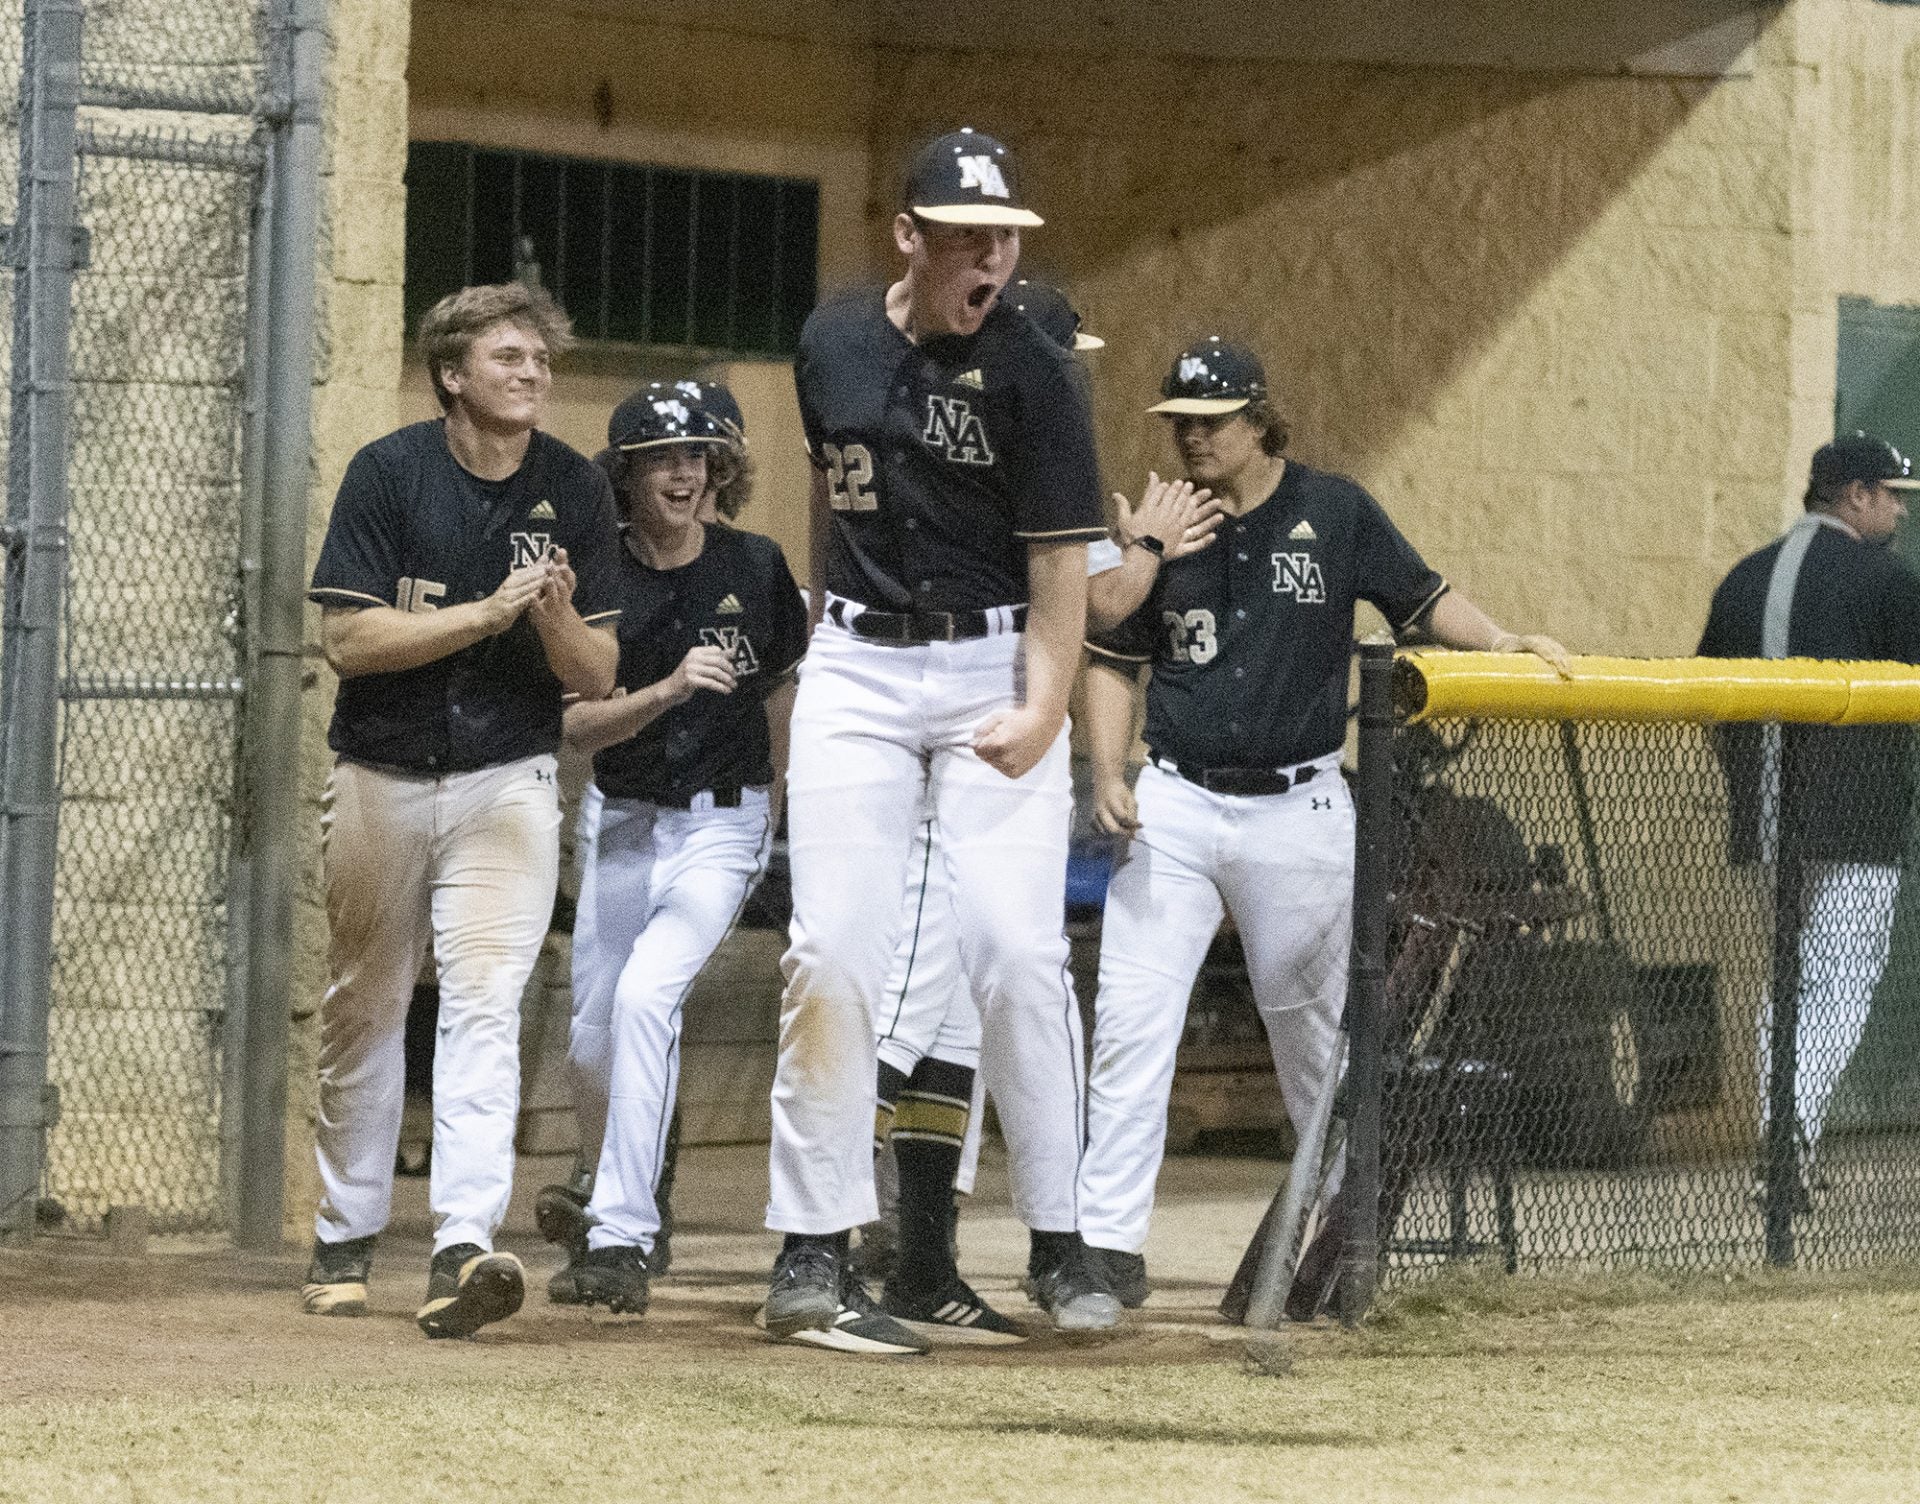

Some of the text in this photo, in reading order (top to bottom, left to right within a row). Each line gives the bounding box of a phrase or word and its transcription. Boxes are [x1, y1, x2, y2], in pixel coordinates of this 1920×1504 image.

[957, 155, 1010, 199] NA
[923, 394, 994, 466] NA
[823, 443, 878, 511] 22
[510, 532, 559, 573] N
[1271, 553, 1326, 603] NA
